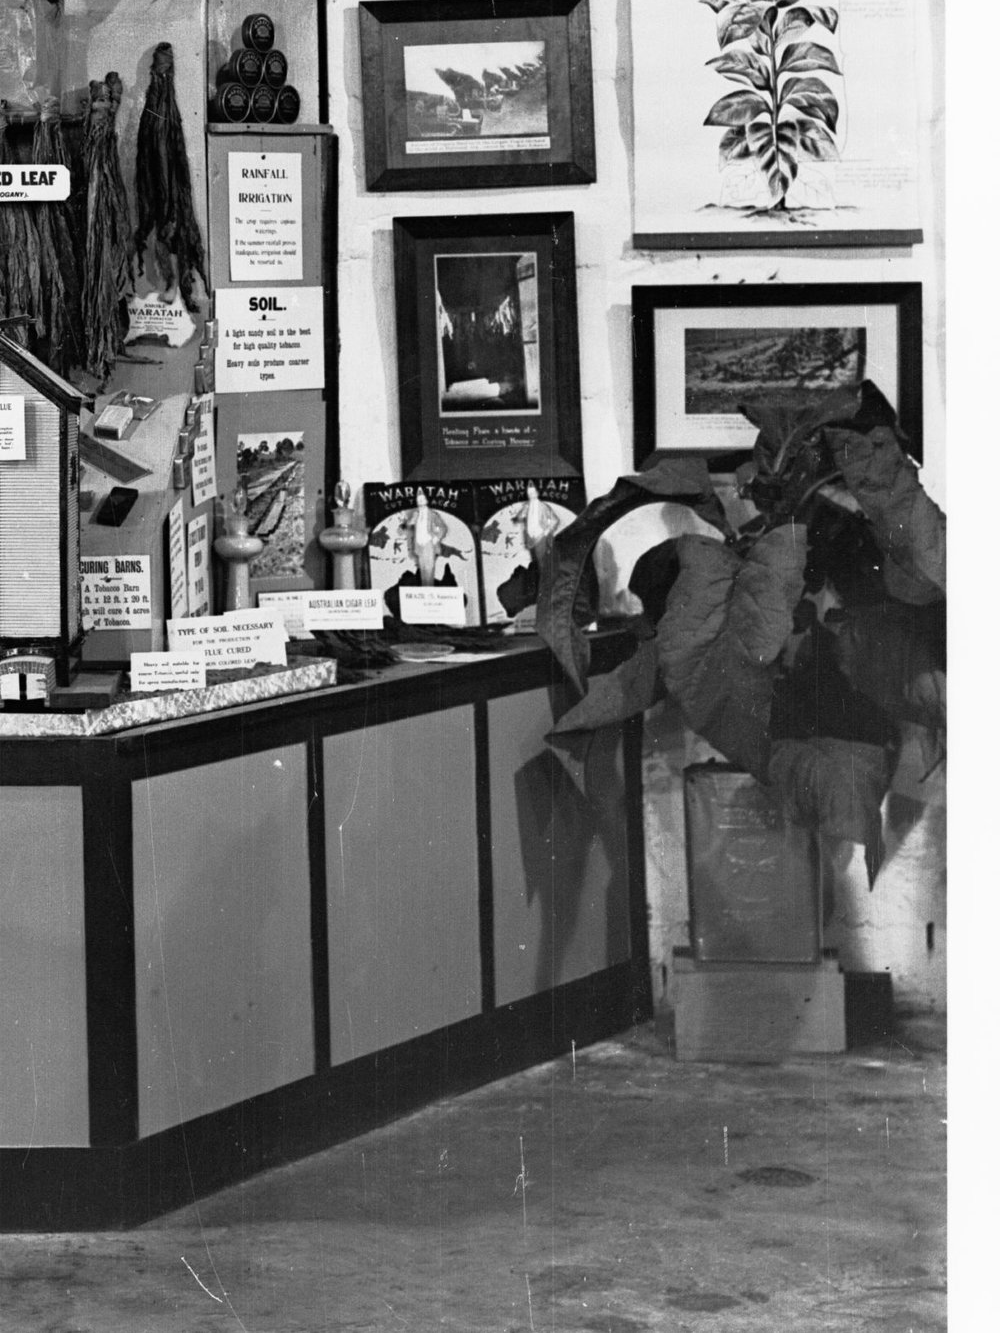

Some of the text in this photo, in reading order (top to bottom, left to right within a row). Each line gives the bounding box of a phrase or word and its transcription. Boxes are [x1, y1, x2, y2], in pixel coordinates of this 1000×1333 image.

[21, 171, 57, 186] LEAF
[242, 168, 288, 179] RAINFALL
[239, 192, 292, 203] IRRIGATION
[249, 296, 287, 311] SOIL.
[128, 308, 183, 318] WARATAH
[225, 329, 230, 337] A
[232, 329, 245, 338] light
[248, 329, 264, 337] sandy
[267, 328, 276, 336] soil
[287, 328, 296, 336] the
[299, 327, 311, 335] best
[233, 342, 241, 350] for
[243, 342, 255, 351] high
[257, 342, 277, 351] quality
[226, 358, 310, 369] Heavy soils produce coarser
[79, 560, 144, 574] CURING BARNS.
[84, 584, 140, 593] A Tobacco Barn
[103, 595, 111, 603] 12
[131, 595, 140, 603] 20
[308, 598, 344, 608] AUSTRALIAN
[364, 598, 377, 607] LEAF
[92, 607, 105, 615] will
[93, 618, 101, 626] of
[178, 622, 274, 636] TYPE OF SOIL NECESSARY
[204, 646, 251, 656] FLUE CURED
